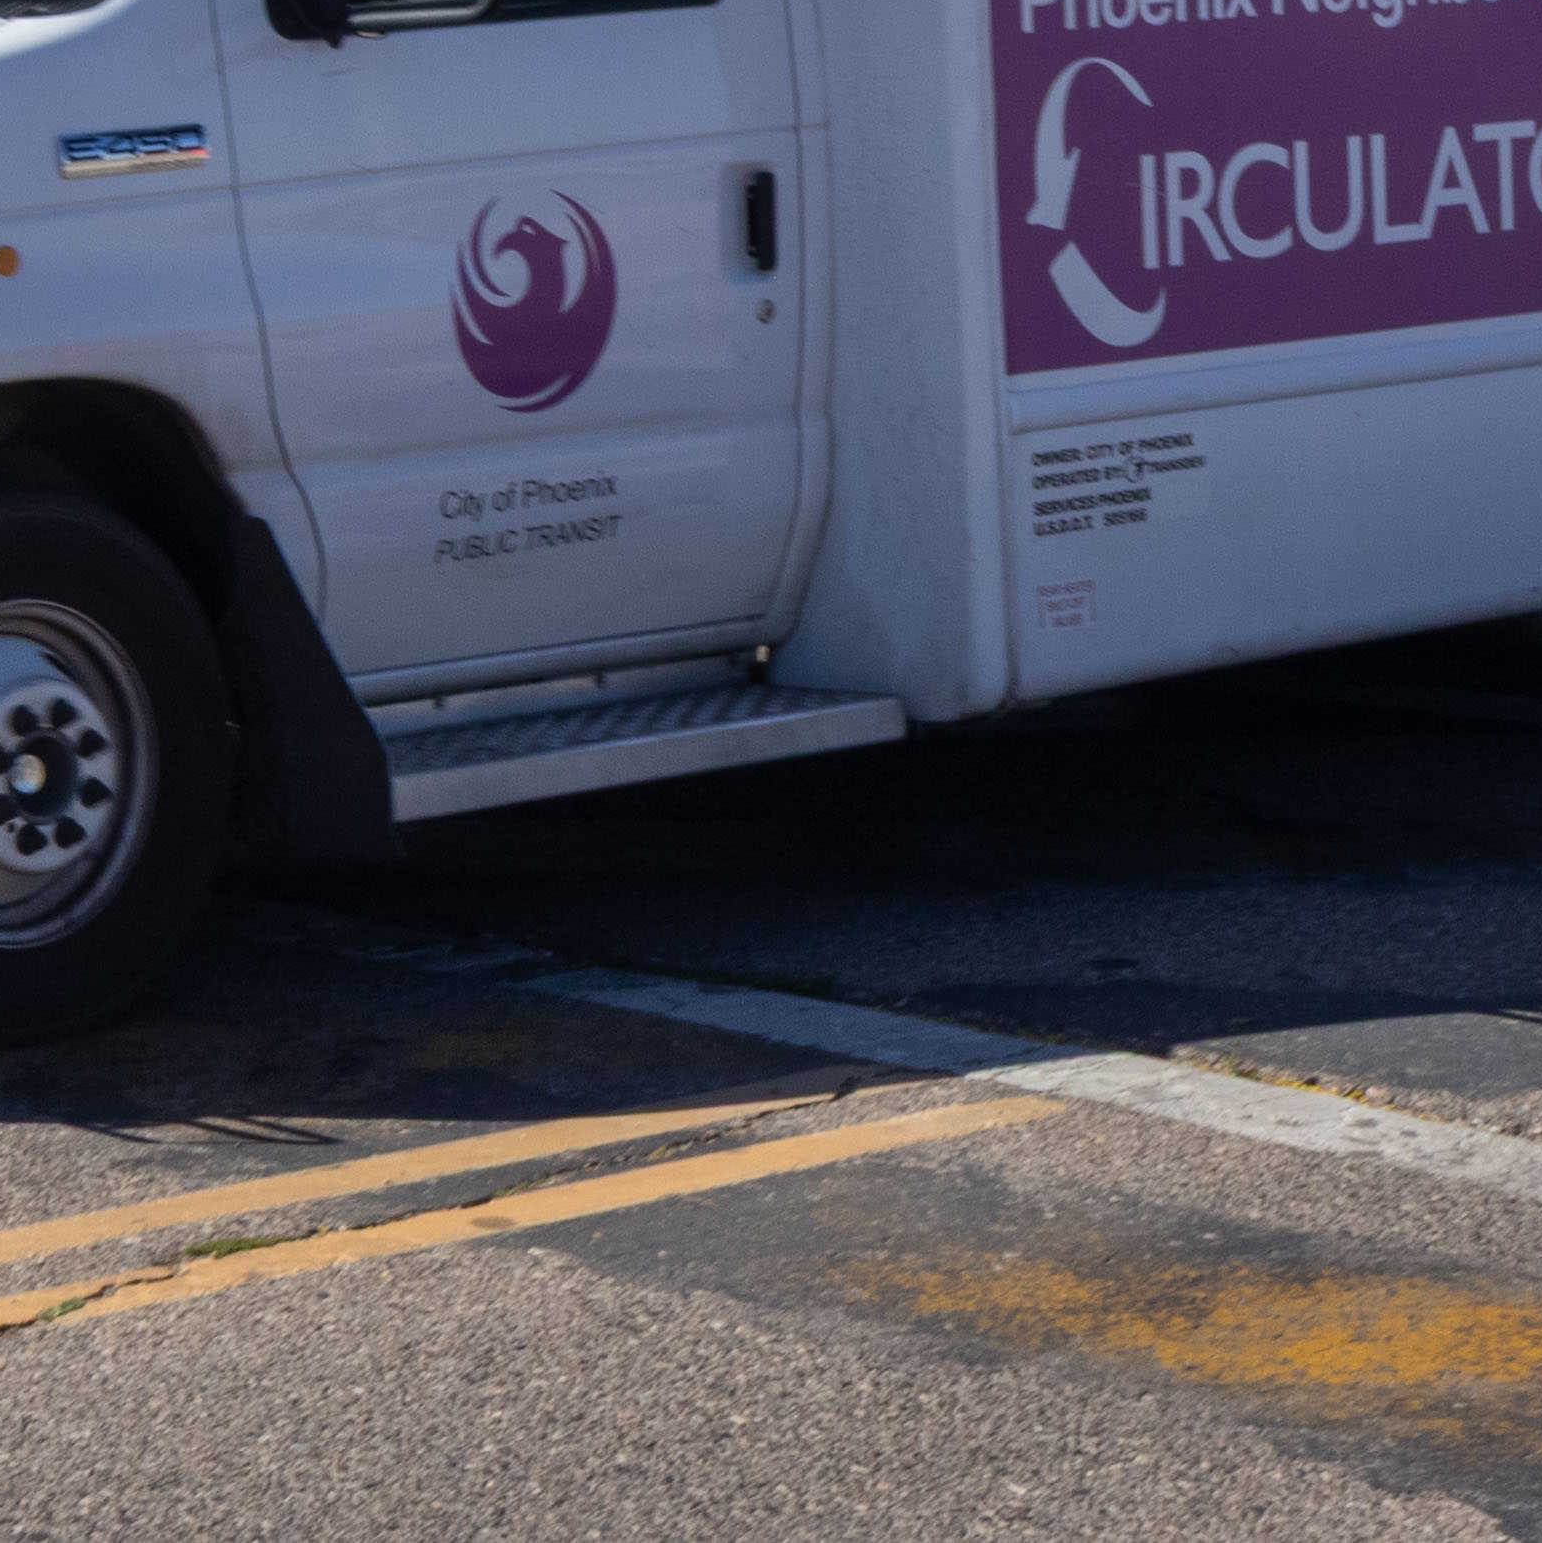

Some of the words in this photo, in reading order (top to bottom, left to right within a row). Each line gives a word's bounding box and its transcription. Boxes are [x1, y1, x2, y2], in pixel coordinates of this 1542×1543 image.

[439, 488, 483, 522] City
[491, 481, 517, 512] of
[521, 470, 618, 508] Phoenix
[432, 530, 519, 565] PUBLIC
[523, 513, 624, 550] TRANSIT
